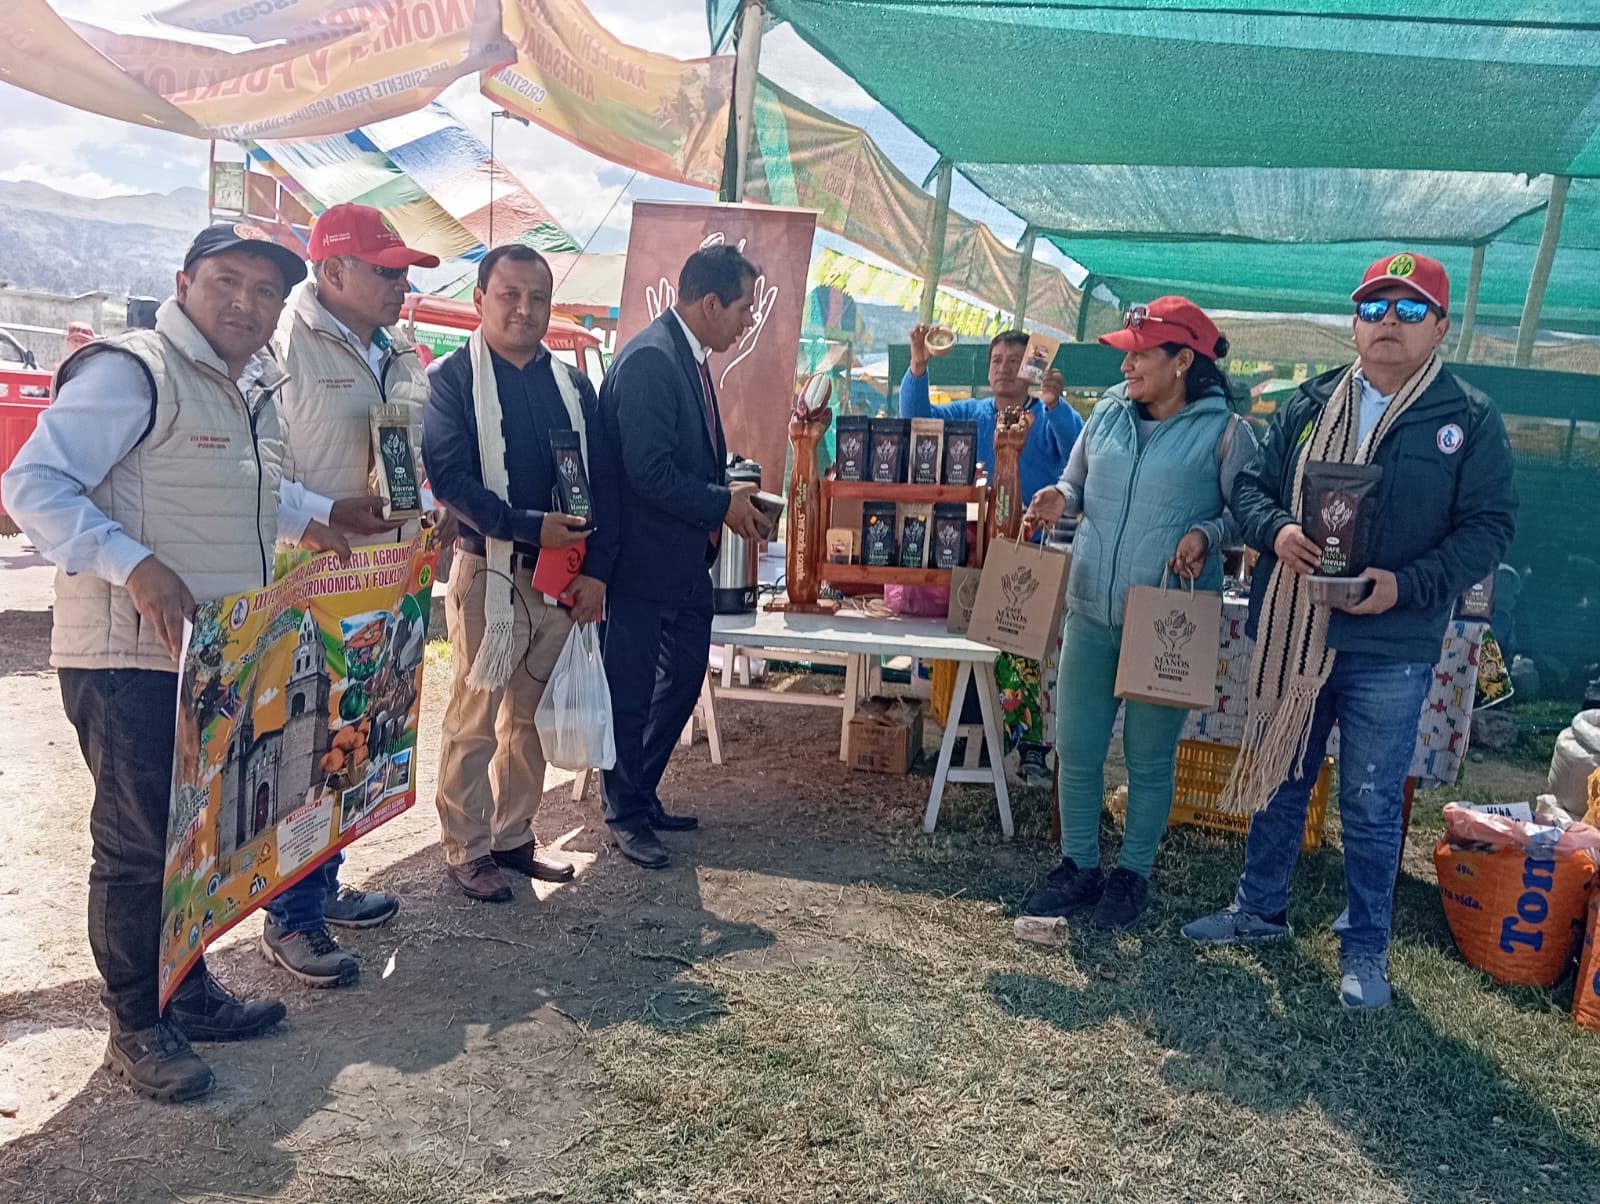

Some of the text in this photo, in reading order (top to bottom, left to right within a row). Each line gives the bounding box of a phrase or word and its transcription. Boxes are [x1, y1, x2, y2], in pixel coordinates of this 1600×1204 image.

[363, 573, 371, 589] Y
[996, 609, 1028, 624] MANOS
[1153, 662, 1190, 677] Morenas
[1154, 655, 1190, 669] MANOS
